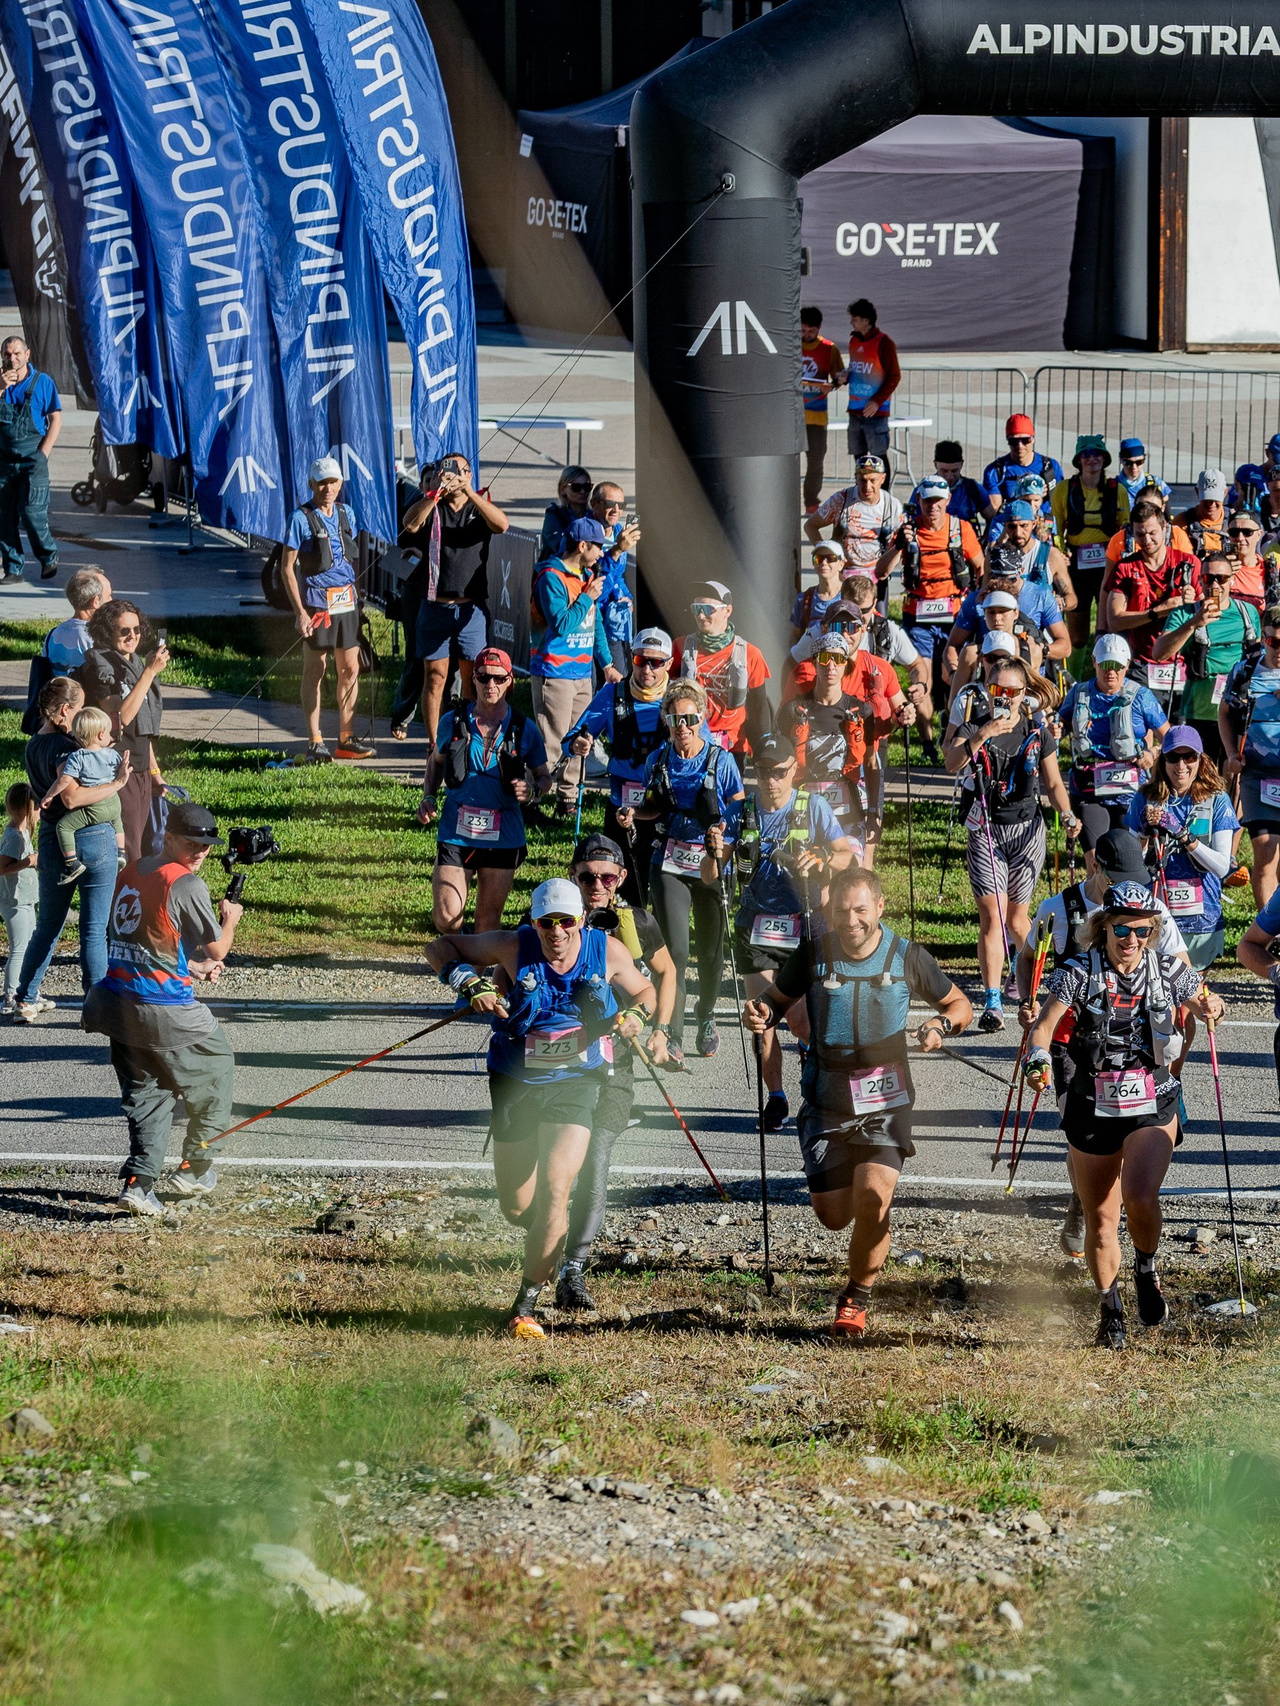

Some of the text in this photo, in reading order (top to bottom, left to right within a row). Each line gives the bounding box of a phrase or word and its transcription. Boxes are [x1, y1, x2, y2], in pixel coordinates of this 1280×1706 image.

[527, 197, 588, 234] GORE-TEX
[836, 221, 1001, 257] GORE-TEX
[901, 258, 932, 268] BRAND
[1086, 549, 1101, 559] 213
[926, 603, 946, 612] 270
[566, 638, 594, 648] TEA
[1105, 771, 1125, 781] 257
[466, 815, 488, 828] 233
[676, 850, 700, 865] 248
[1166, 889, 1190, 902] 253
[764, 920, 788, 934] 255
[541, 1041, 571, 1055] 273
[867, 1077, 894, 1094] 275
[1108, 1083, 1140, 1099] 264
